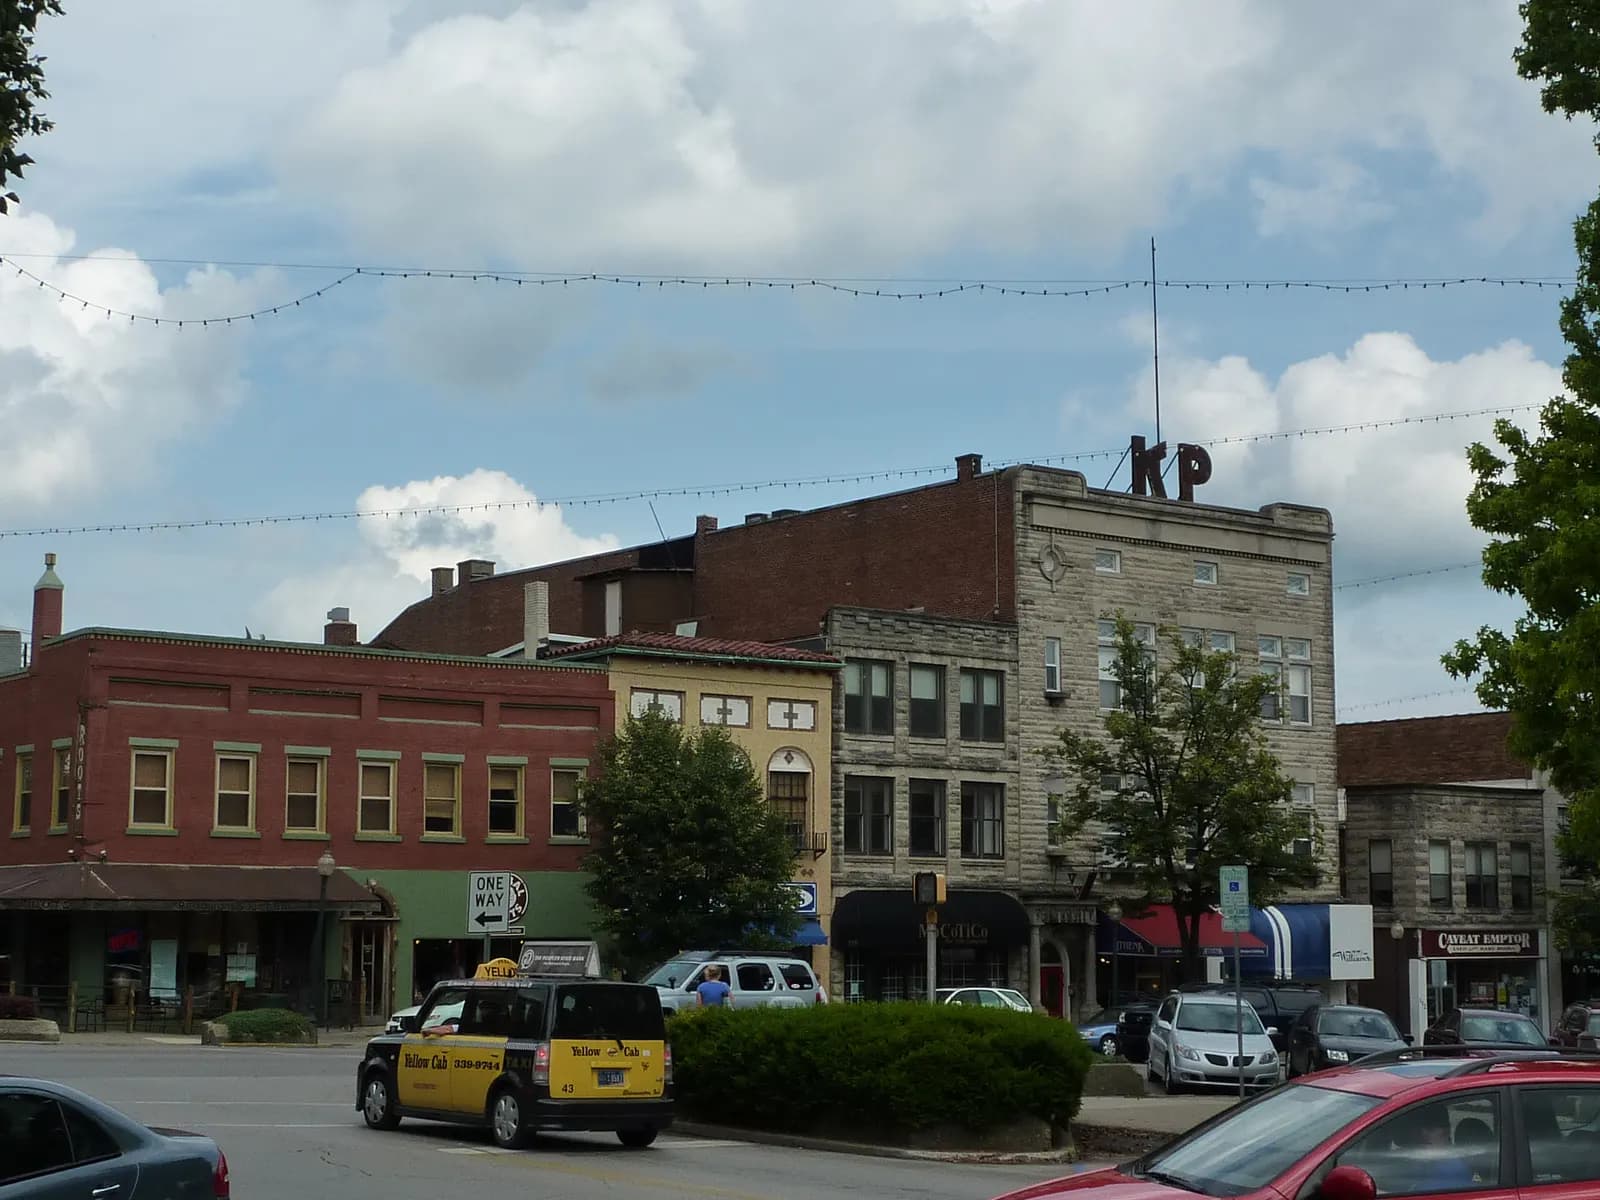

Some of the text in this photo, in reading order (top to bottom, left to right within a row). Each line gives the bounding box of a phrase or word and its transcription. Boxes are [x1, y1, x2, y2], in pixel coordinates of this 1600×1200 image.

[477, 876, 504, 890] ONE
[475, 893, 504, 907] WAY
[1438, 933, 1530, 949] CAVEAT EMPTOR
[484, 966, 518, 978] YELLO
[571, 1046, 640, 1057] Yellow Cab
[404, 1053, 429, 1068] Yellow
[431, 1055, 448, 1070] Cab
[454, 1059, 500, 1070] 339-9744
[562, 1084, 574, 1094] 43
